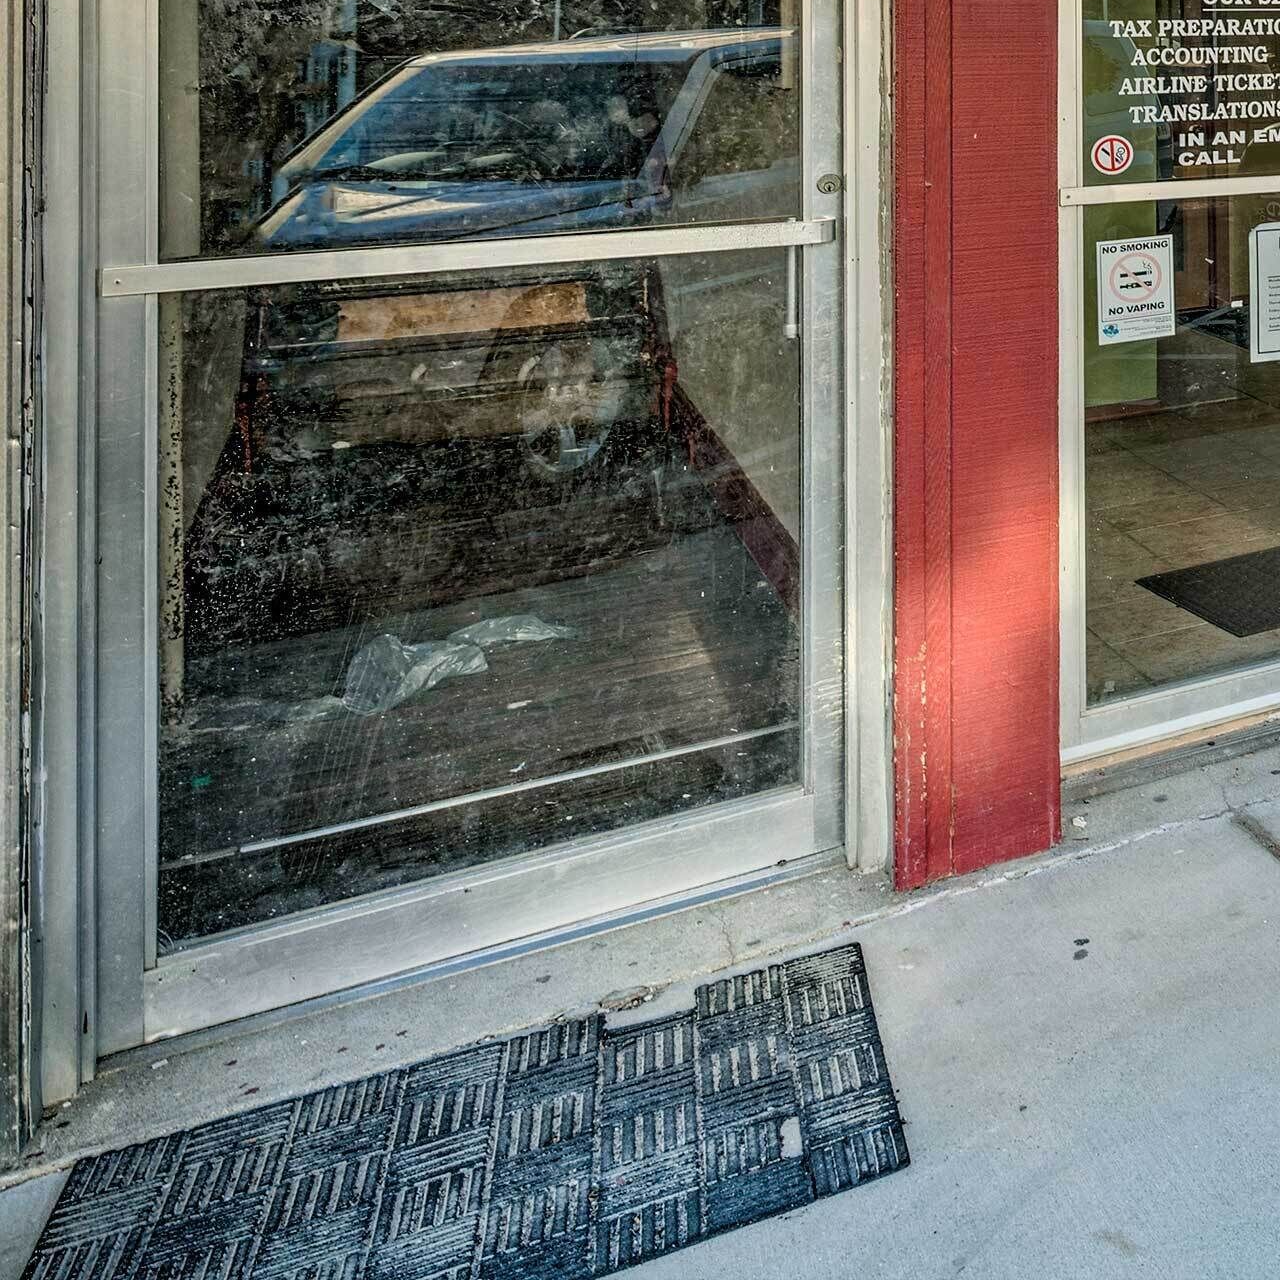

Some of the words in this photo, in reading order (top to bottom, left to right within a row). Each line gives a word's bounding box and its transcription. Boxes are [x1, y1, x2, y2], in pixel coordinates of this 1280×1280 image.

[1109, 20, 1153, 37] TAX
[1131, 46, 1269, 66] ACCOUNTING
[1118, 75, 1208, 95] AIRLINE
[1178, 132, 1205, 148] IN
[1212, 130, 1246, 146] AN
[1178, 150, 1241, 167] CALL
[1102, 245, 1118, 254] NO
[1120, 240, 1168, 253] SMOKING
[1108, 307, 1124, 316] NO
[1126, 301, 1165, 313] VAPING
